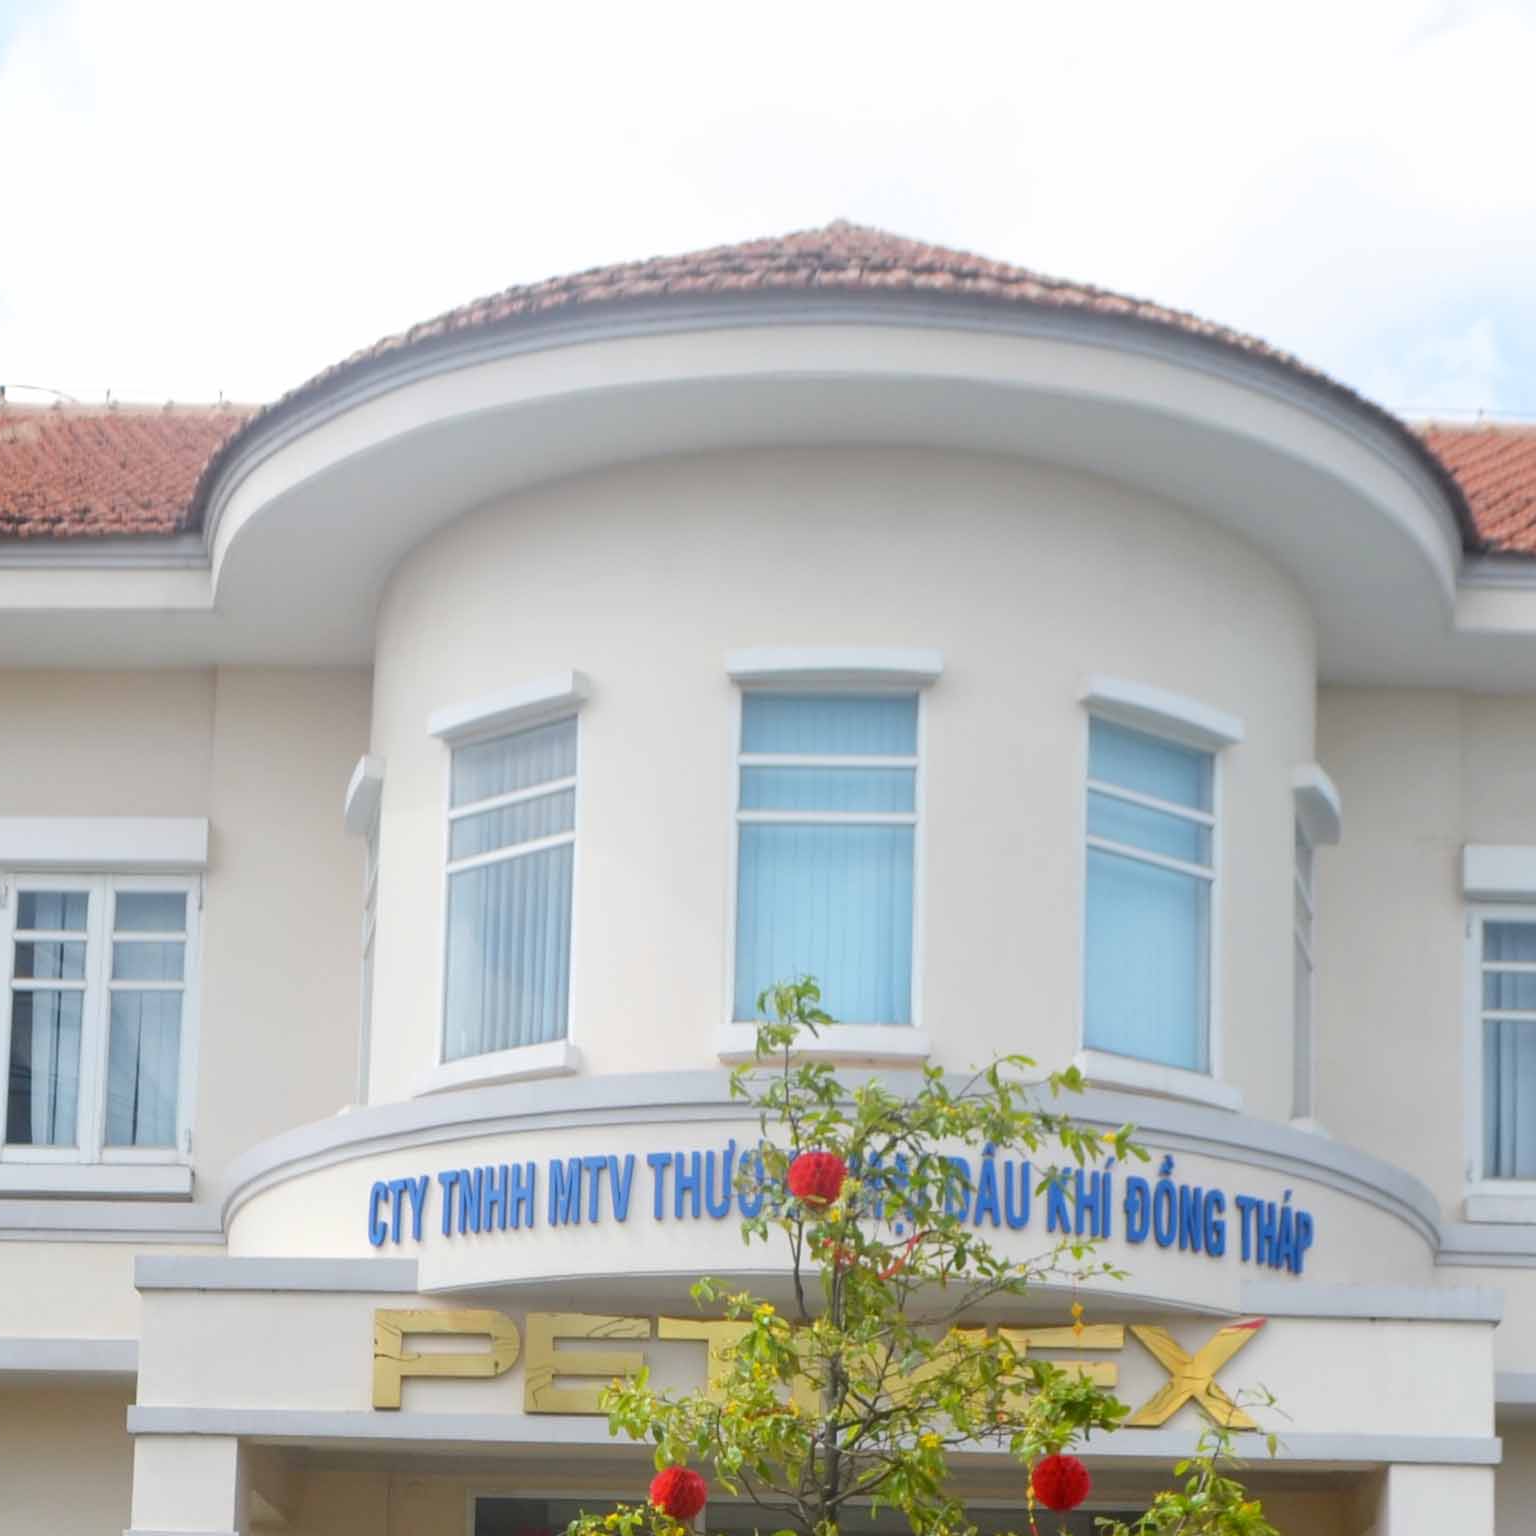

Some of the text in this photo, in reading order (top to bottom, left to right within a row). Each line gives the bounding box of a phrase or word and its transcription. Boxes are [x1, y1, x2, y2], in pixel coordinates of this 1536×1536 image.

[368, 1174, 430, 1247] CTY
[438, 1161, 537, 1238] TNHH
[548, 1153, 636, 1227] MTV
[647, 1139, 840, 1223] THƯƠ
[1046, 1157, 1116, 1240] KHÍ
[1235, 1189, 1313, 1275] THÁP
